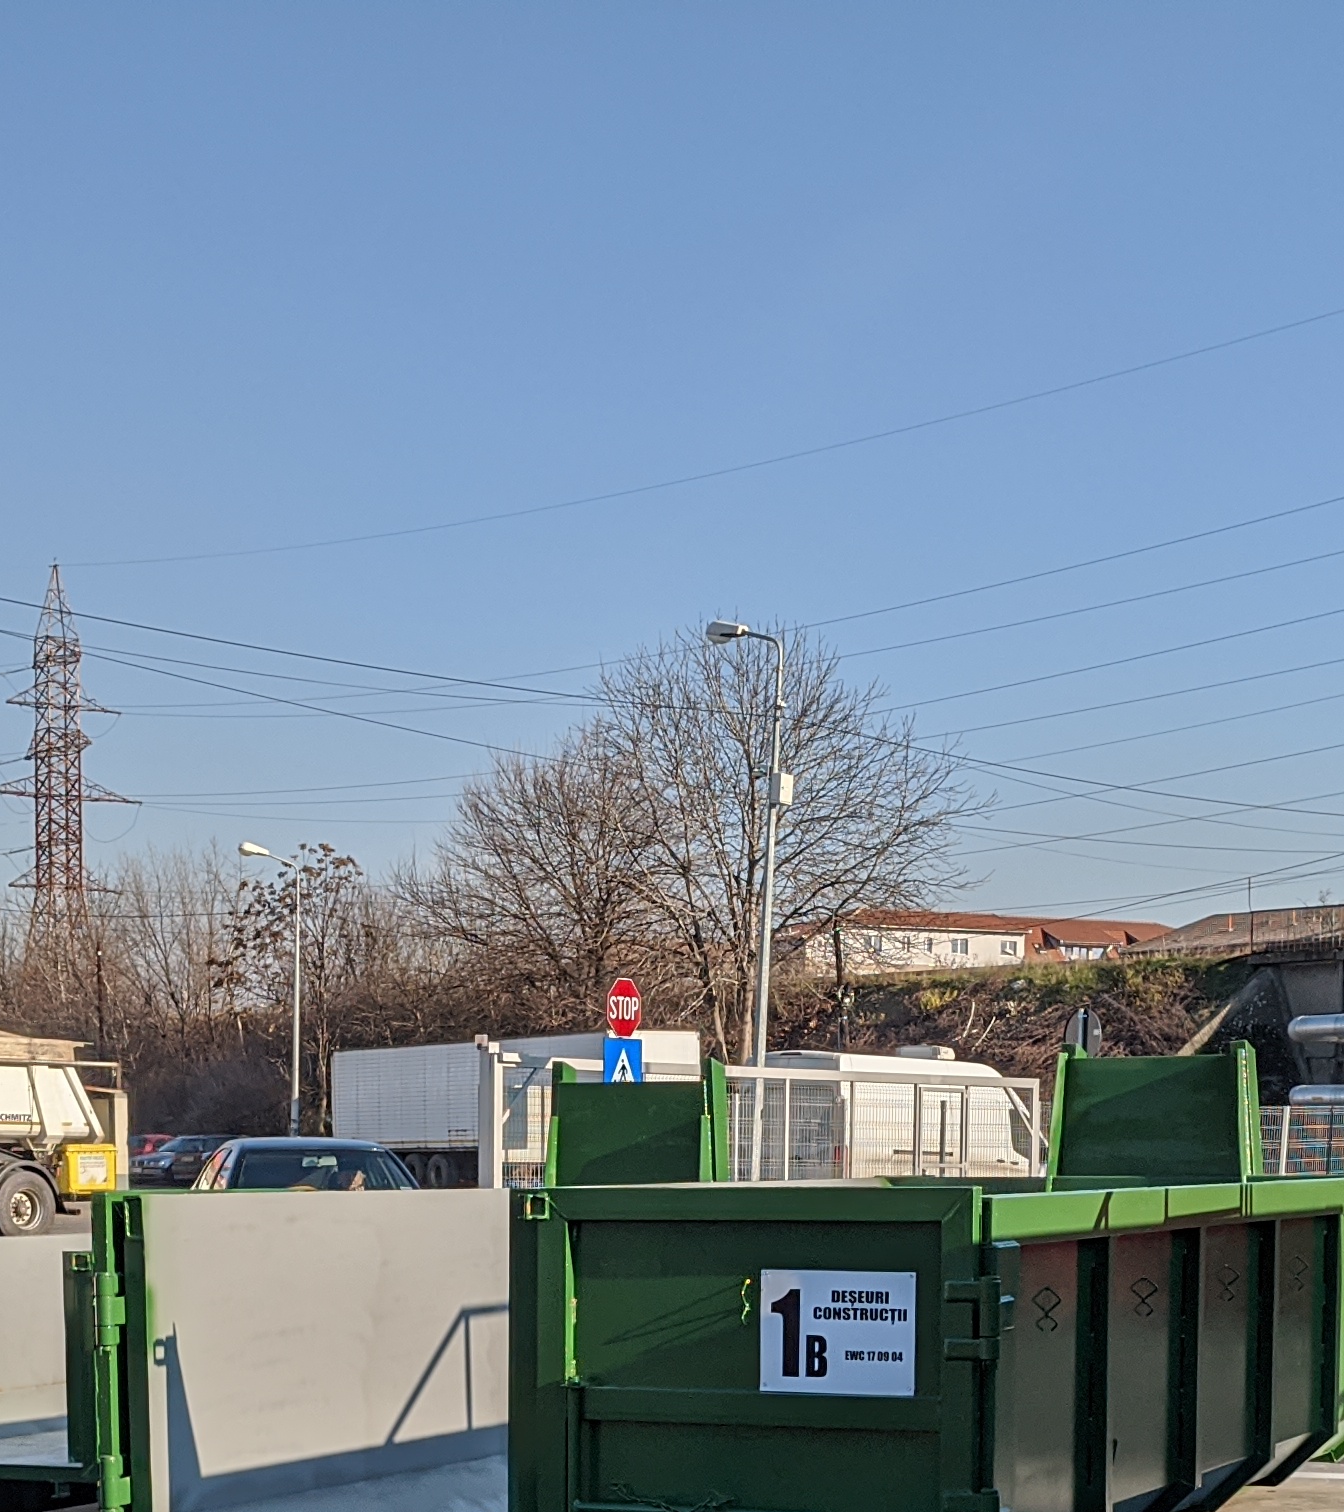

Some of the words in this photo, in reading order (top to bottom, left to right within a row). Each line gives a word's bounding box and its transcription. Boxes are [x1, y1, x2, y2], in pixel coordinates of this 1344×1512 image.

[609, 995, 639, 1020] STOP
[771, 1288, 801, 1377] 1
[805, 1334, 828, 1377] B
[844, 1350, 865, 1361] EWC
[866, 1351, 877, 1361] 17
[877, 1351, 890, 1362] 09
[891, 1351, 903, 1363] 04
